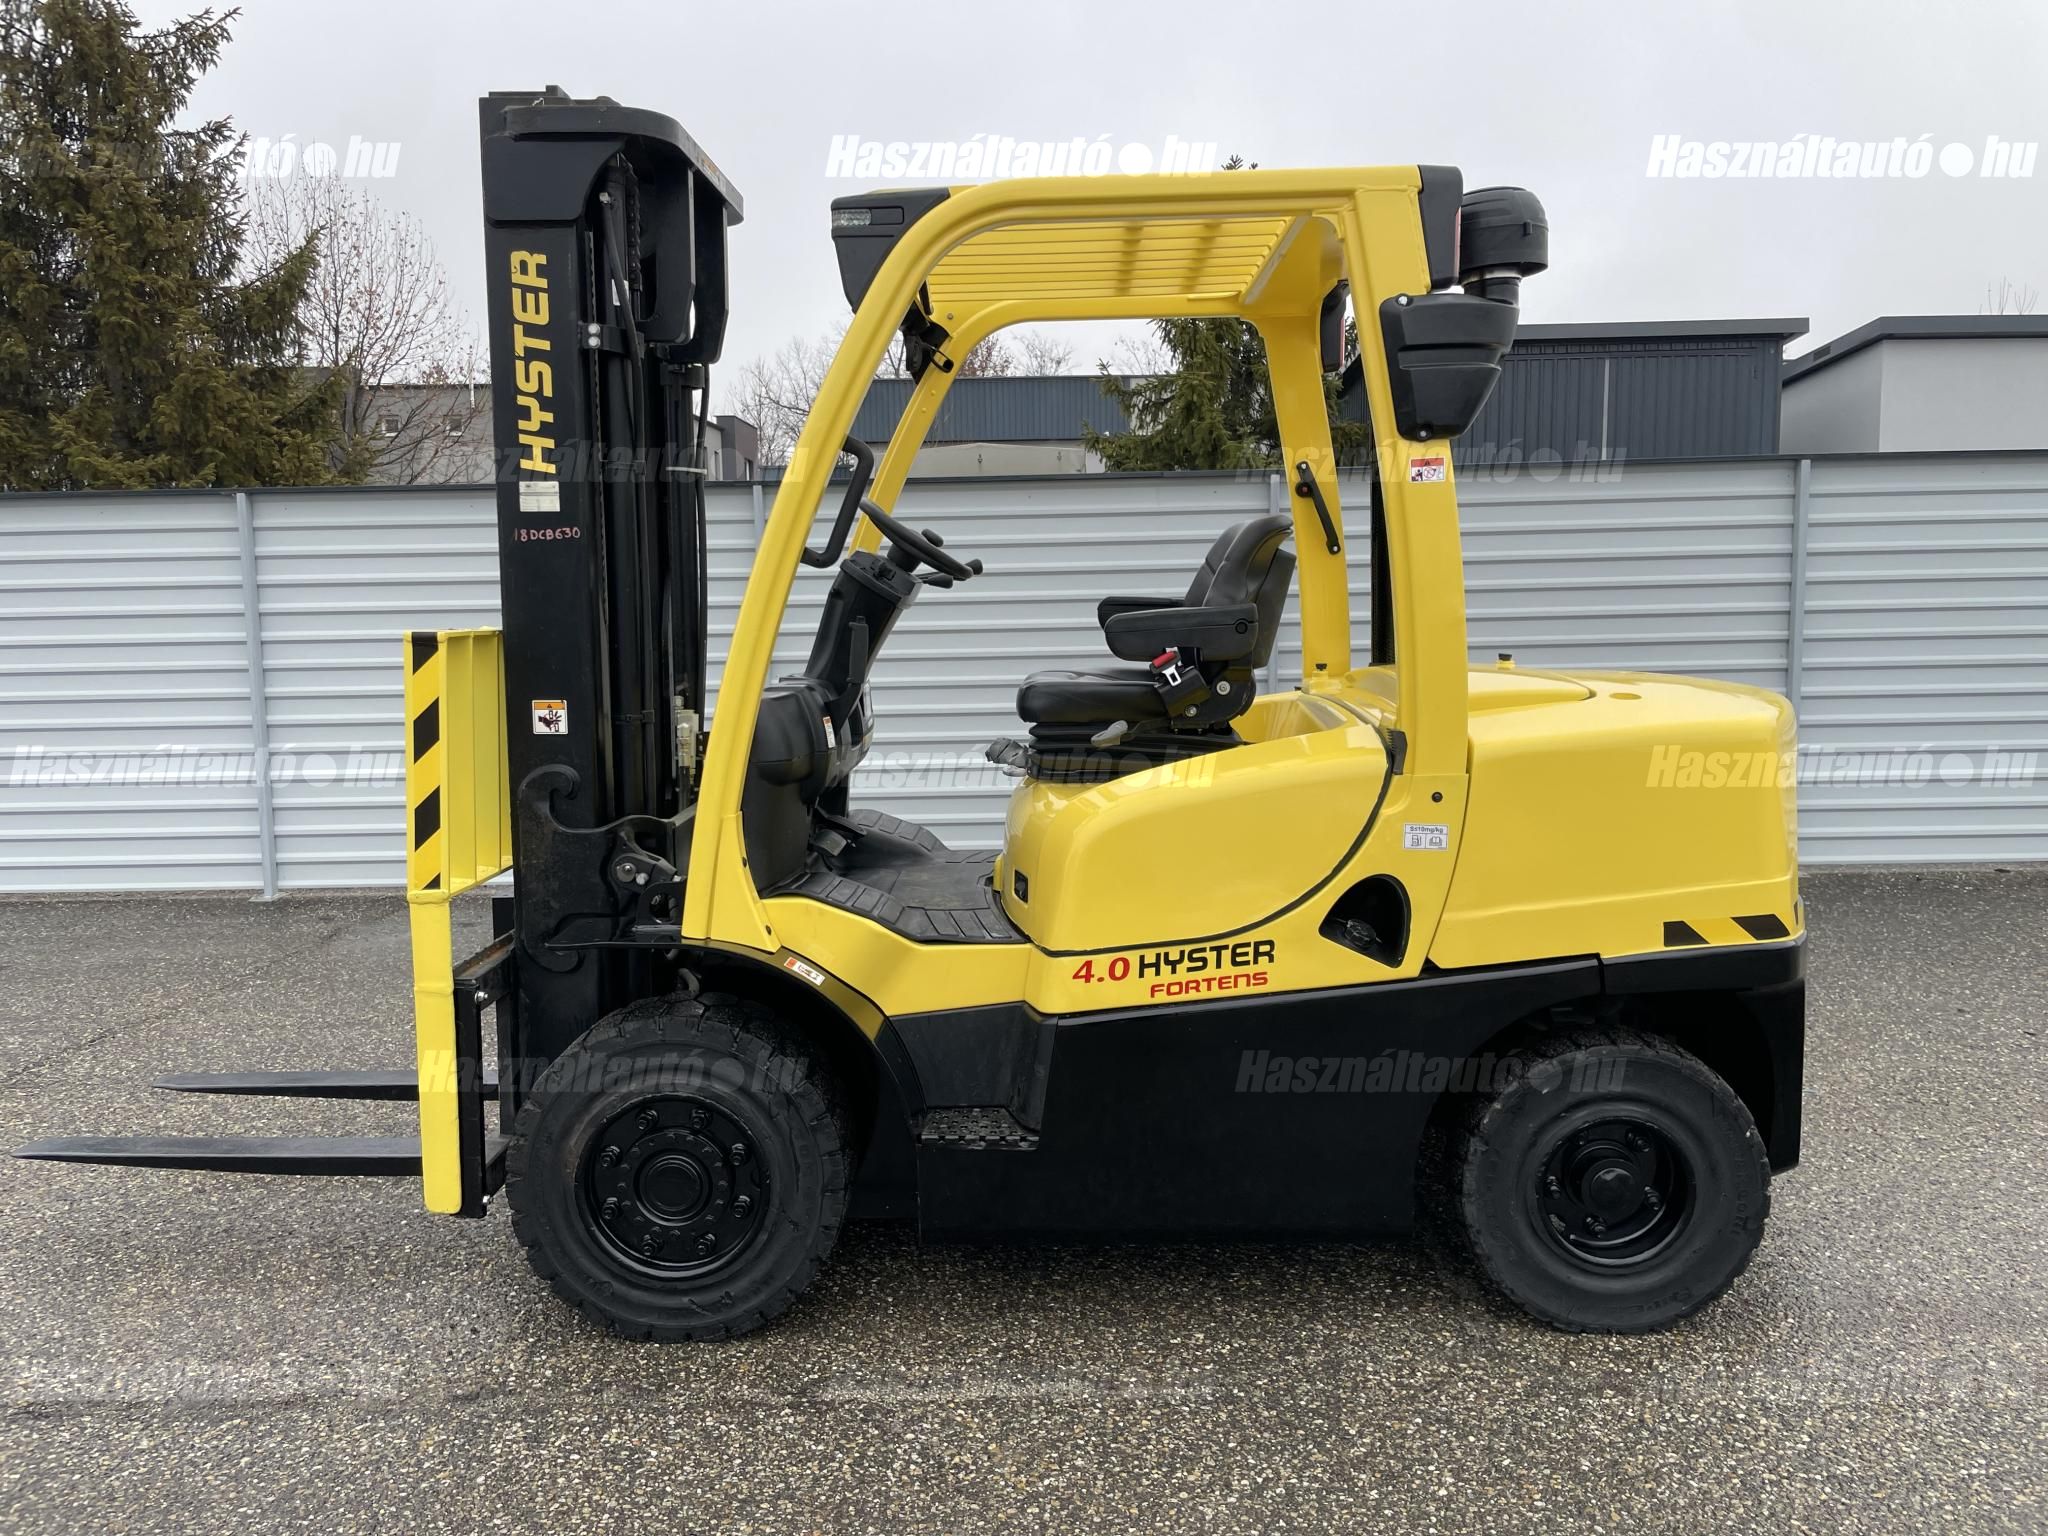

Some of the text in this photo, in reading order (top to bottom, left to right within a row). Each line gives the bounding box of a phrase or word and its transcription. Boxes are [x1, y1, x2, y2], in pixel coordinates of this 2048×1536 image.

[511, 250, 557, 474] HYSTER
[1072, 939, 1276, 984] 4.0 HYSTER
[1150, 971, 1269, 998] FORTENS
